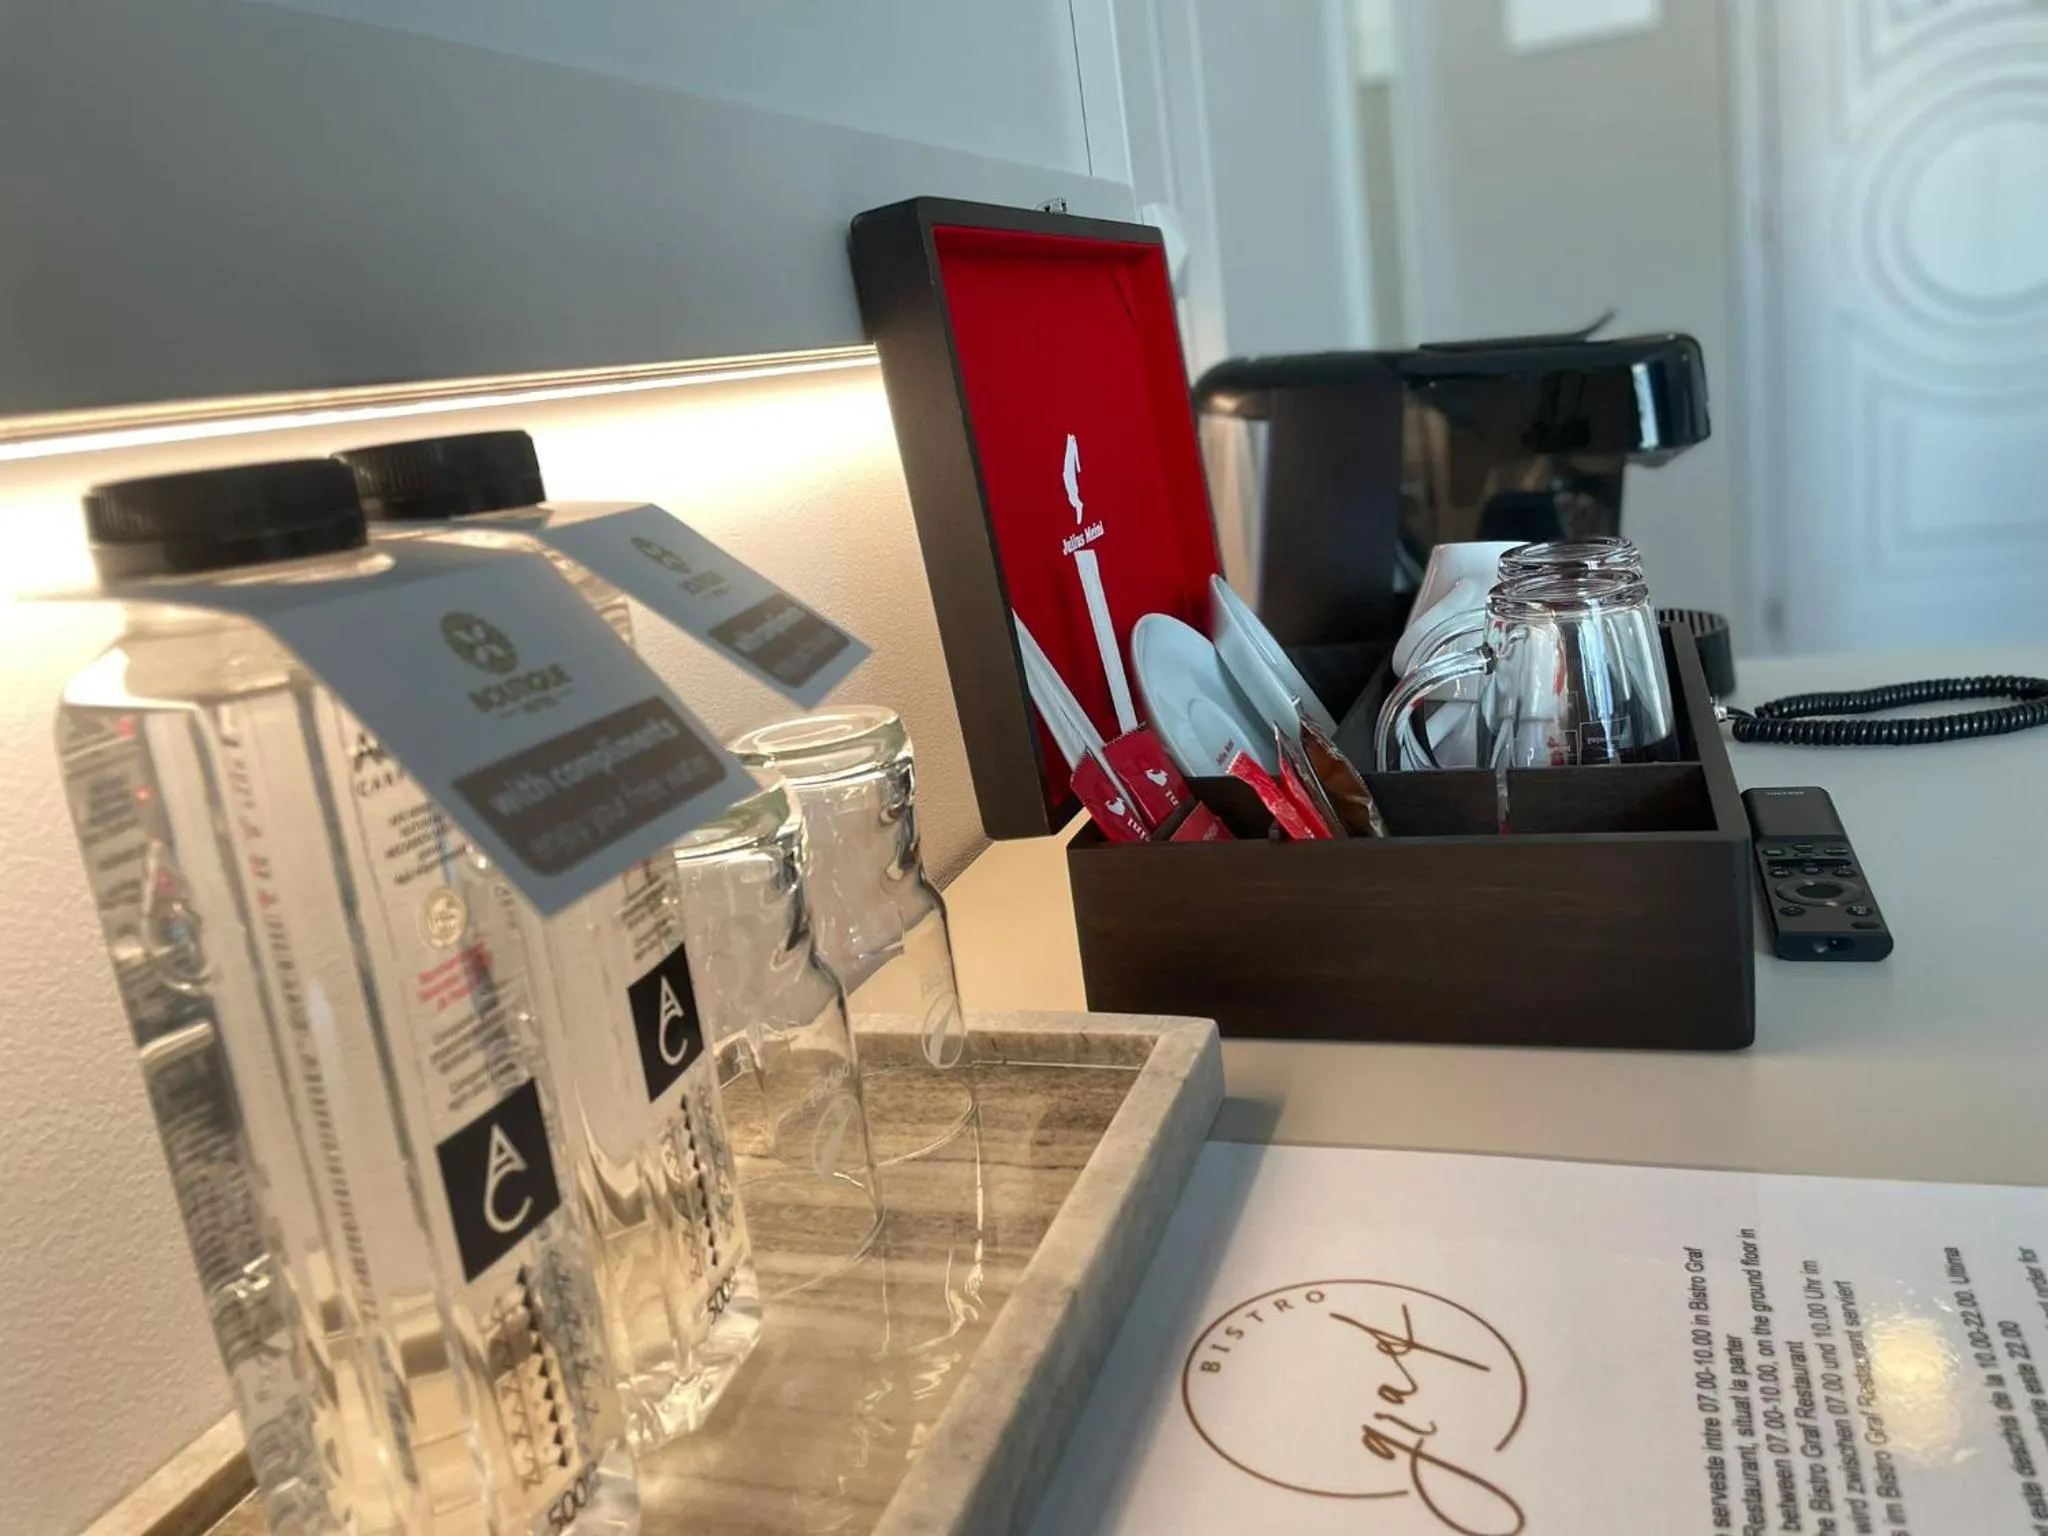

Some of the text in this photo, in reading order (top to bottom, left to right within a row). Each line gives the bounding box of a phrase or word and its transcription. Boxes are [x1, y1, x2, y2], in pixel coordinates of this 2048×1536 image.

[1737, 1228, 1756, 1239] in
[1740, 1240, 1760, 1267] floor
[1682, 1245, 1704, 1273] Graf
[1688, 1275, 1709, 1311] Bistro
[1742, 1269, 1774, 1313] ground
[1832, 1279, 1862, 1327] serviert
[1200, 1290, 1326, 1374] BISTRO
[1751, 1314, 1773, 1336] the
[1757, 1339, 1776, 1357] on
[1690, 1328, 1720, 1413] 07.00-10.00
[1784, 1340, 1818, 1420] Restaurant
[1799, 1259, 1873, 1534] wird zwischen 07.00 und 10.00 Uhr im
[1796, 1420, 1824, 1458] Graf
[1858, 1409, 1890, 1445] Graf
[1774, 1458, 1802, 1531] between
[1807, 1462, 1834, 1512] Bistro
[1874, 1449, 1903, 1498] Bistro
